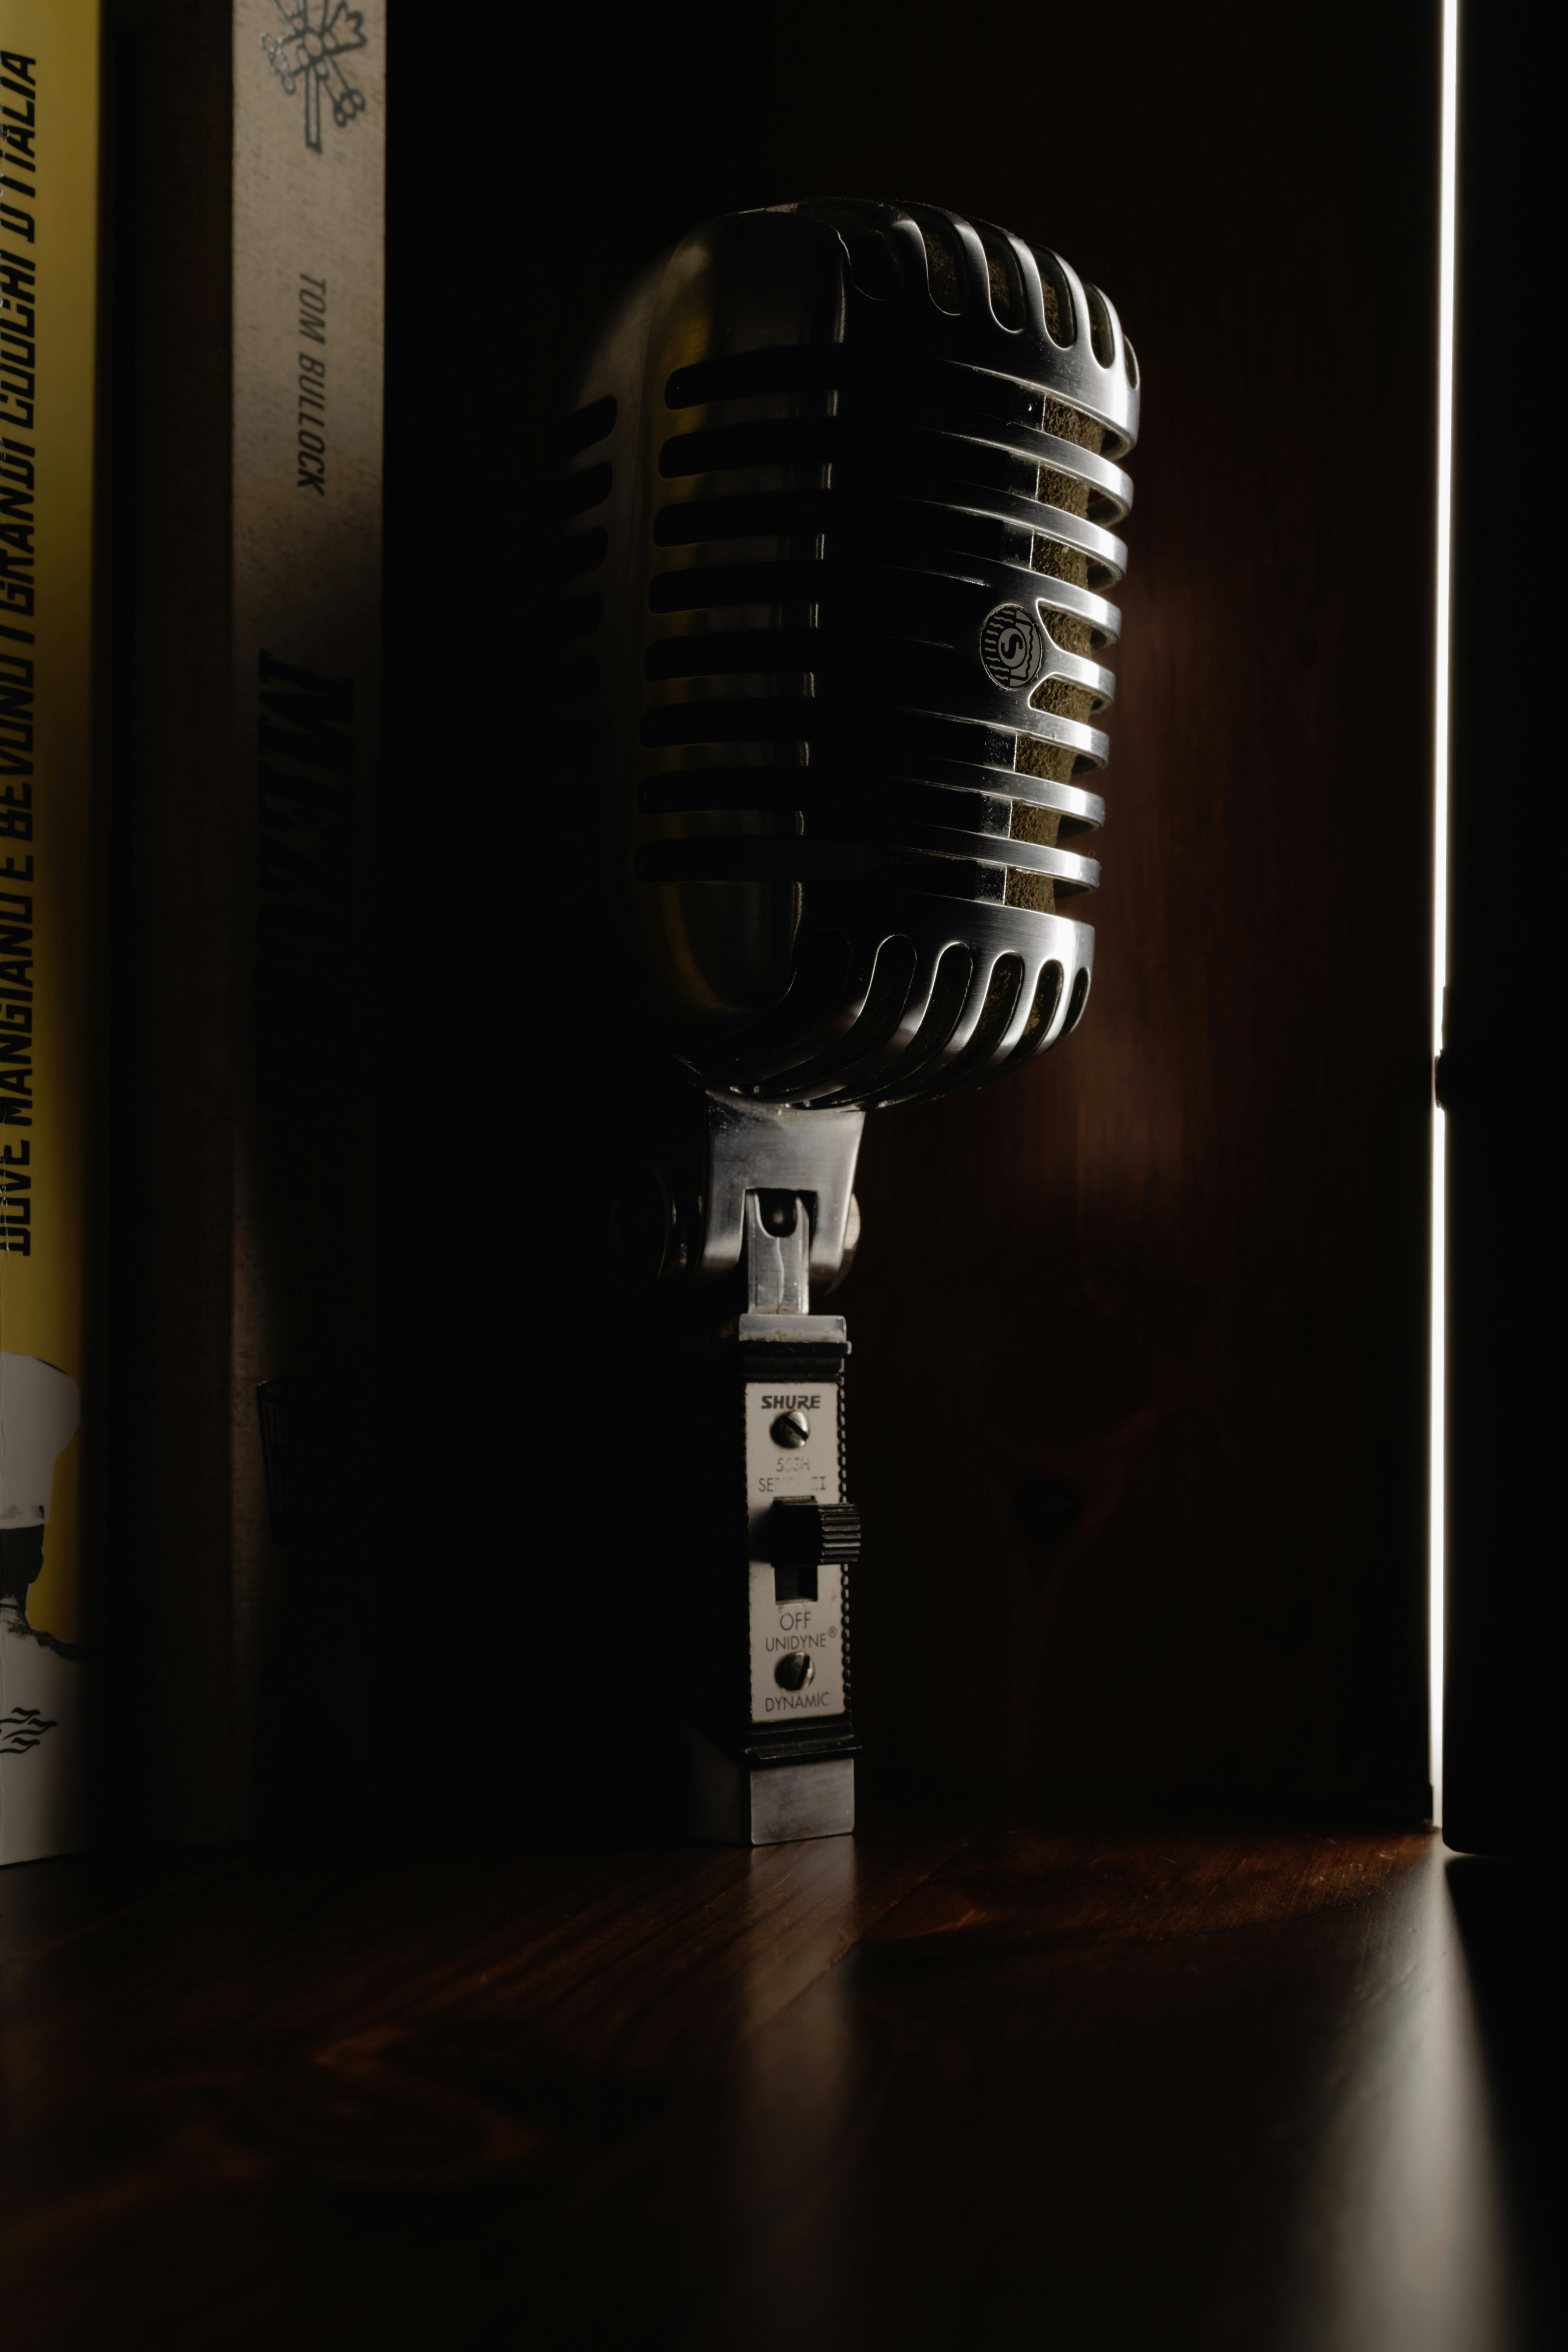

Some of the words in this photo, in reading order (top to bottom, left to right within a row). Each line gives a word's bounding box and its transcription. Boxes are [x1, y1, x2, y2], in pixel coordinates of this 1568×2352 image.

[0, 51, 36, 243] DITALIA
[0, 250, 35, 429] CUOCHI
[299, 273, 326, 345] TOM
[297, 352, 326, 496] BULLOCK
[0, 435, 35, 616] GRANDI
[0, 626, 34, 644] I
[0, 653, 34, 841] BEVONO
[0, 855, 33, 881] E
[0, 893, 32, 1126] MANGIANO
[0, 1140, 31, 1256] DOVE
[761, 1395, 821, 1410] SHURE
[780, 1612, 811, 1631] OFF
[765, 1692, 830, 1712] DYNAMIC
